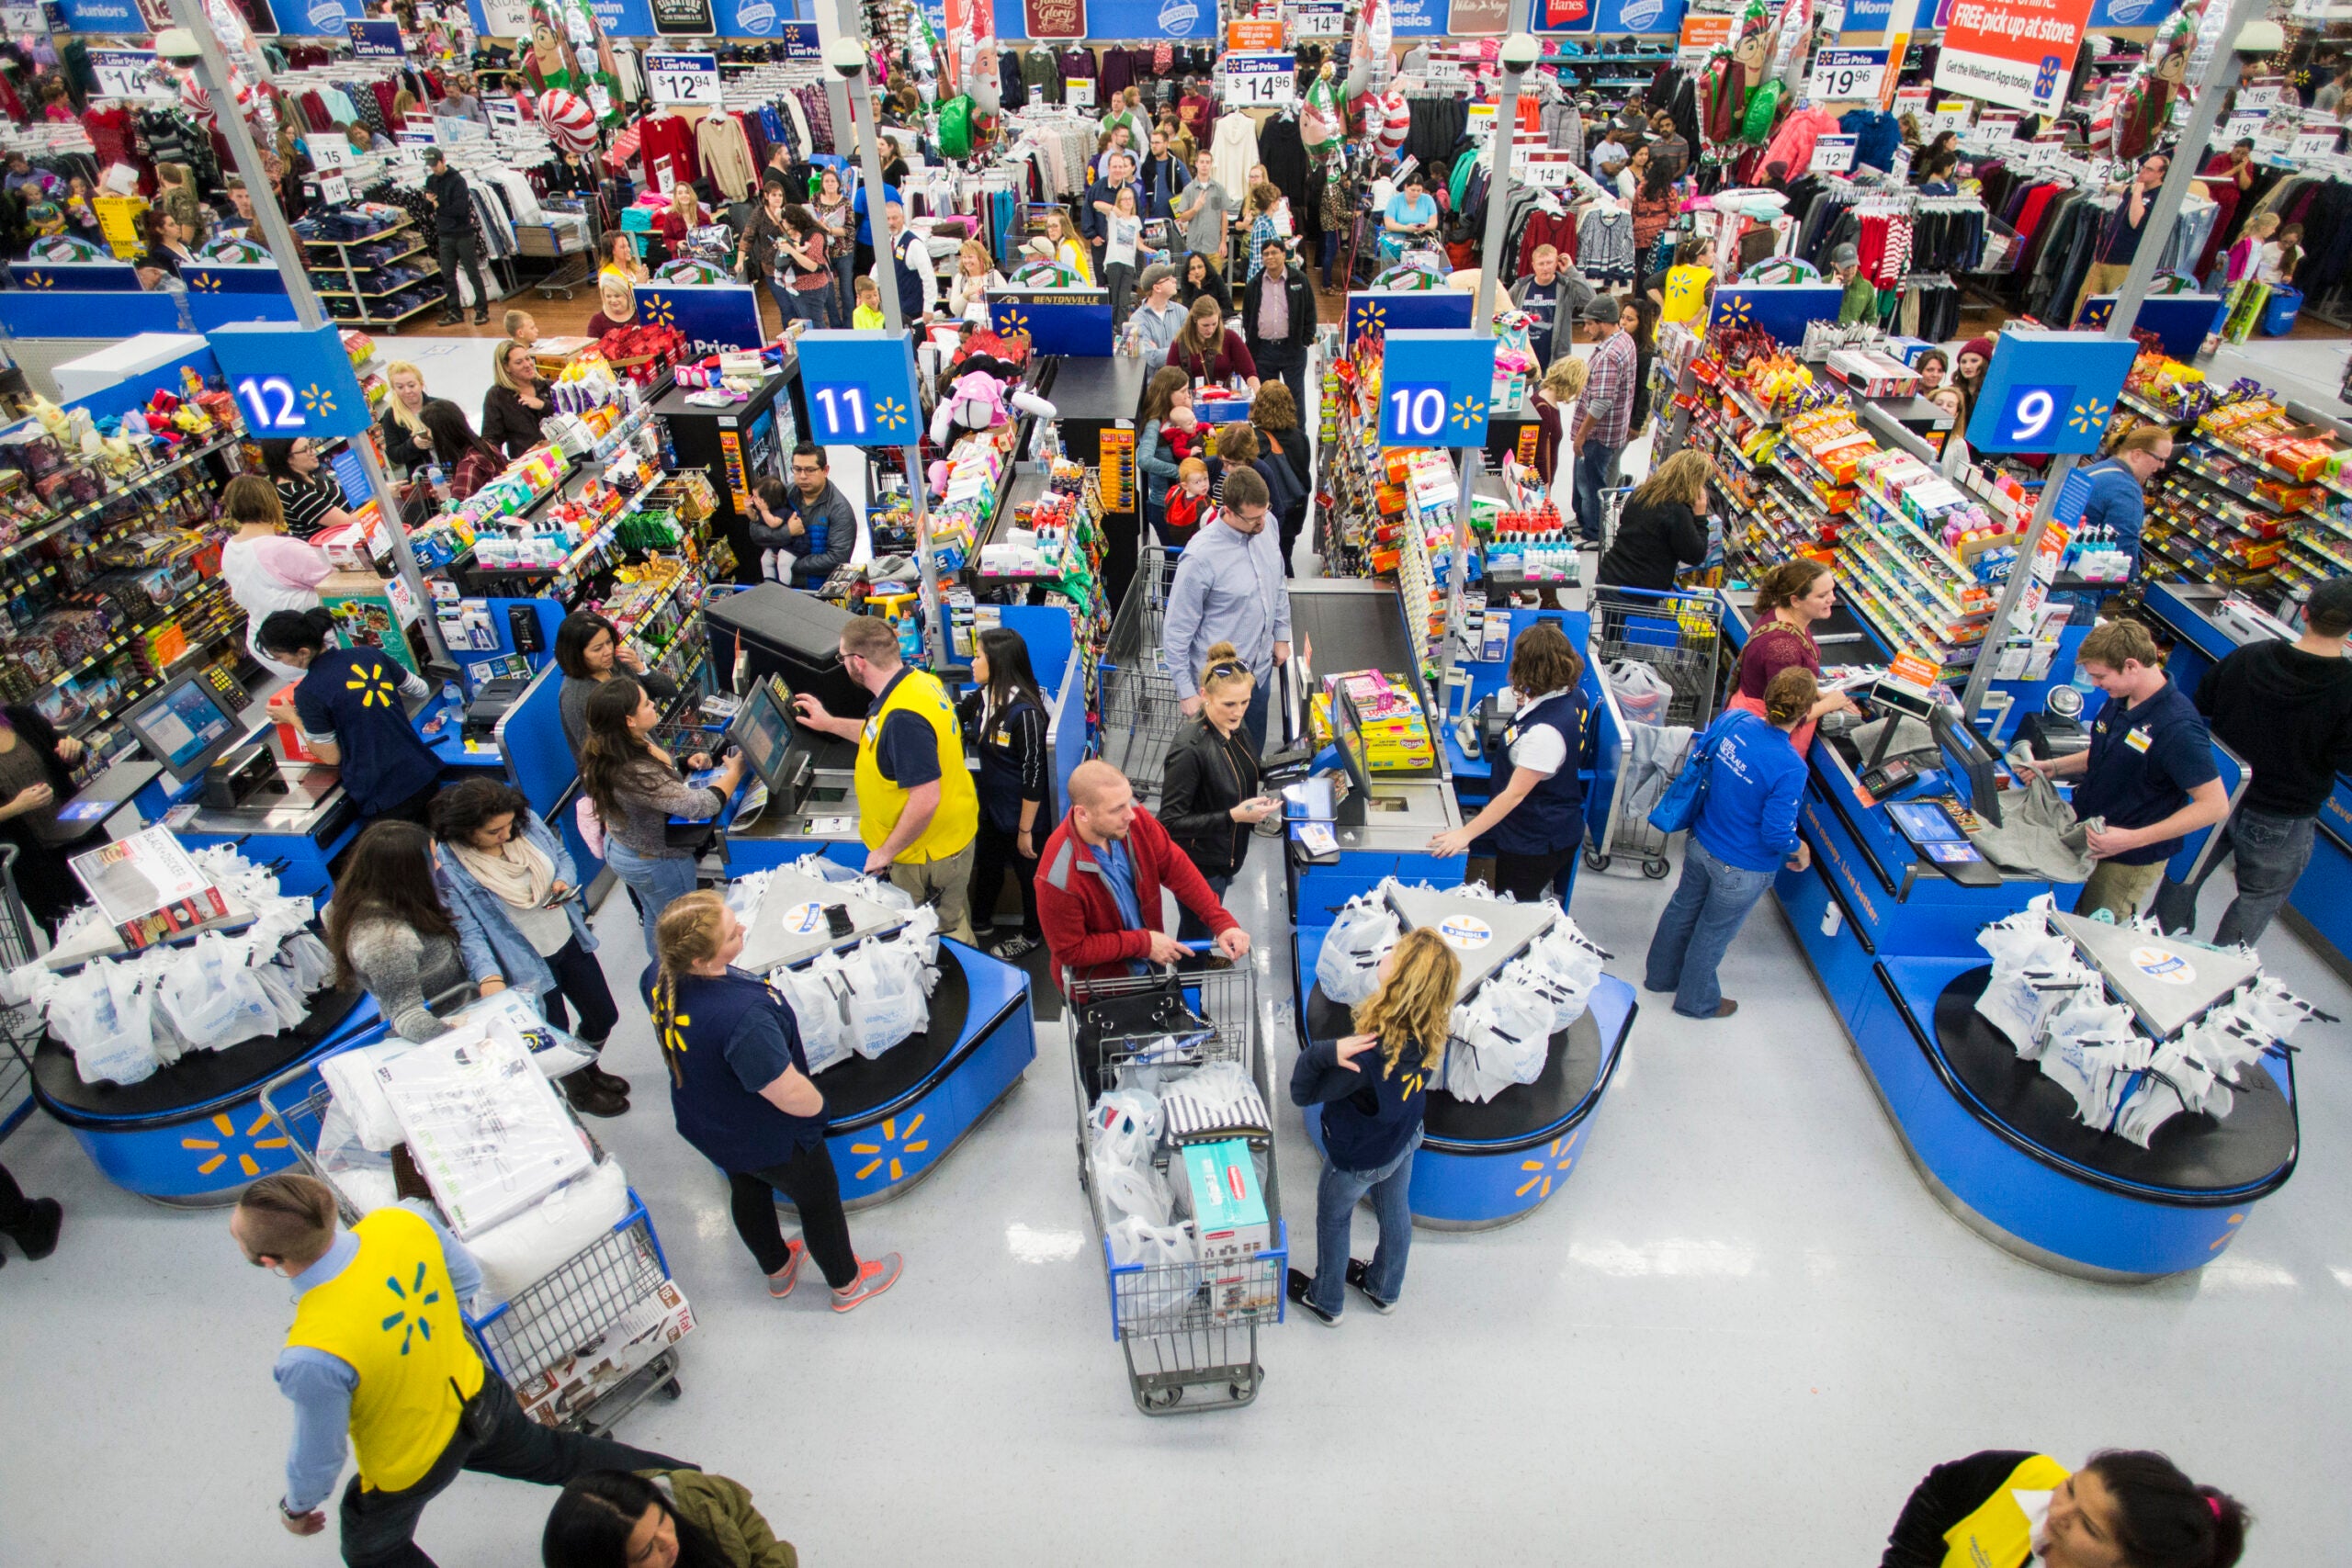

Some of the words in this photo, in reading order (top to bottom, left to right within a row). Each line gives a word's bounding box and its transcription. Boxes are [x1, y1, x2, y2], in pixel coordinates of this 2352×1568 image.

[75, 5, 128, 17] Juniors
[1550, 0, 1584, 10] Hanes
[507, 13, 525, 24] Lee
[1953, 4, 1980, 28] FREE
[1979, 9, 2006, 36] pick
[2007, 16, 2024, 42] up
[2025, 18, 2039, 38] at
[2039, 21, 2075, 44] store.
[356, 45, 374, 54] Low
[375, 46, 395, 54] Price
[788, 48, 806, 56] Low
[107, 57, 123, 66] Low
[662, 62, 679, 70] Low
[680, 62, 700, 71] Price
[1241, 62, 1258, 71] Low
[1259, 62, 1279, 71] Price
[1833, 56, 1850, 64] Low
[1851, 57, 1872, 65] Price
[1946, 60, 1957, 73] Get
[1957, 62, 1967, 75] the
[1968, 65, 1996, 83] Walmart
[1996, 71, 2010, 88] App
[2011, 73, 2033, 90] today.
[94, 198, 124, 207] STANLEY
[1033, 295, 1100, 303] BENTONVILLE
[694, 339, 741, 355] Price
[1777, 341, 1801, 356] ice
[238, 378, 306, 426] 12
[816, 388, 866, 435] 11
[1391, 388, 1446, 435] 10
[2011, 390, 2054, 441] 9
[2326, 795, 2352, 824] Save
[1805, 803, 1820, 829] Save
[1819, 827, 1840, 866] money.
[1841, 860, 1856, 888] Live
[1854, 881, 1879, 926] better.
[1455, 929, 1487, 939] THINK
[660, 1286, 673, 1301] 18
[676, 1305, 694, 1335] T-fal
